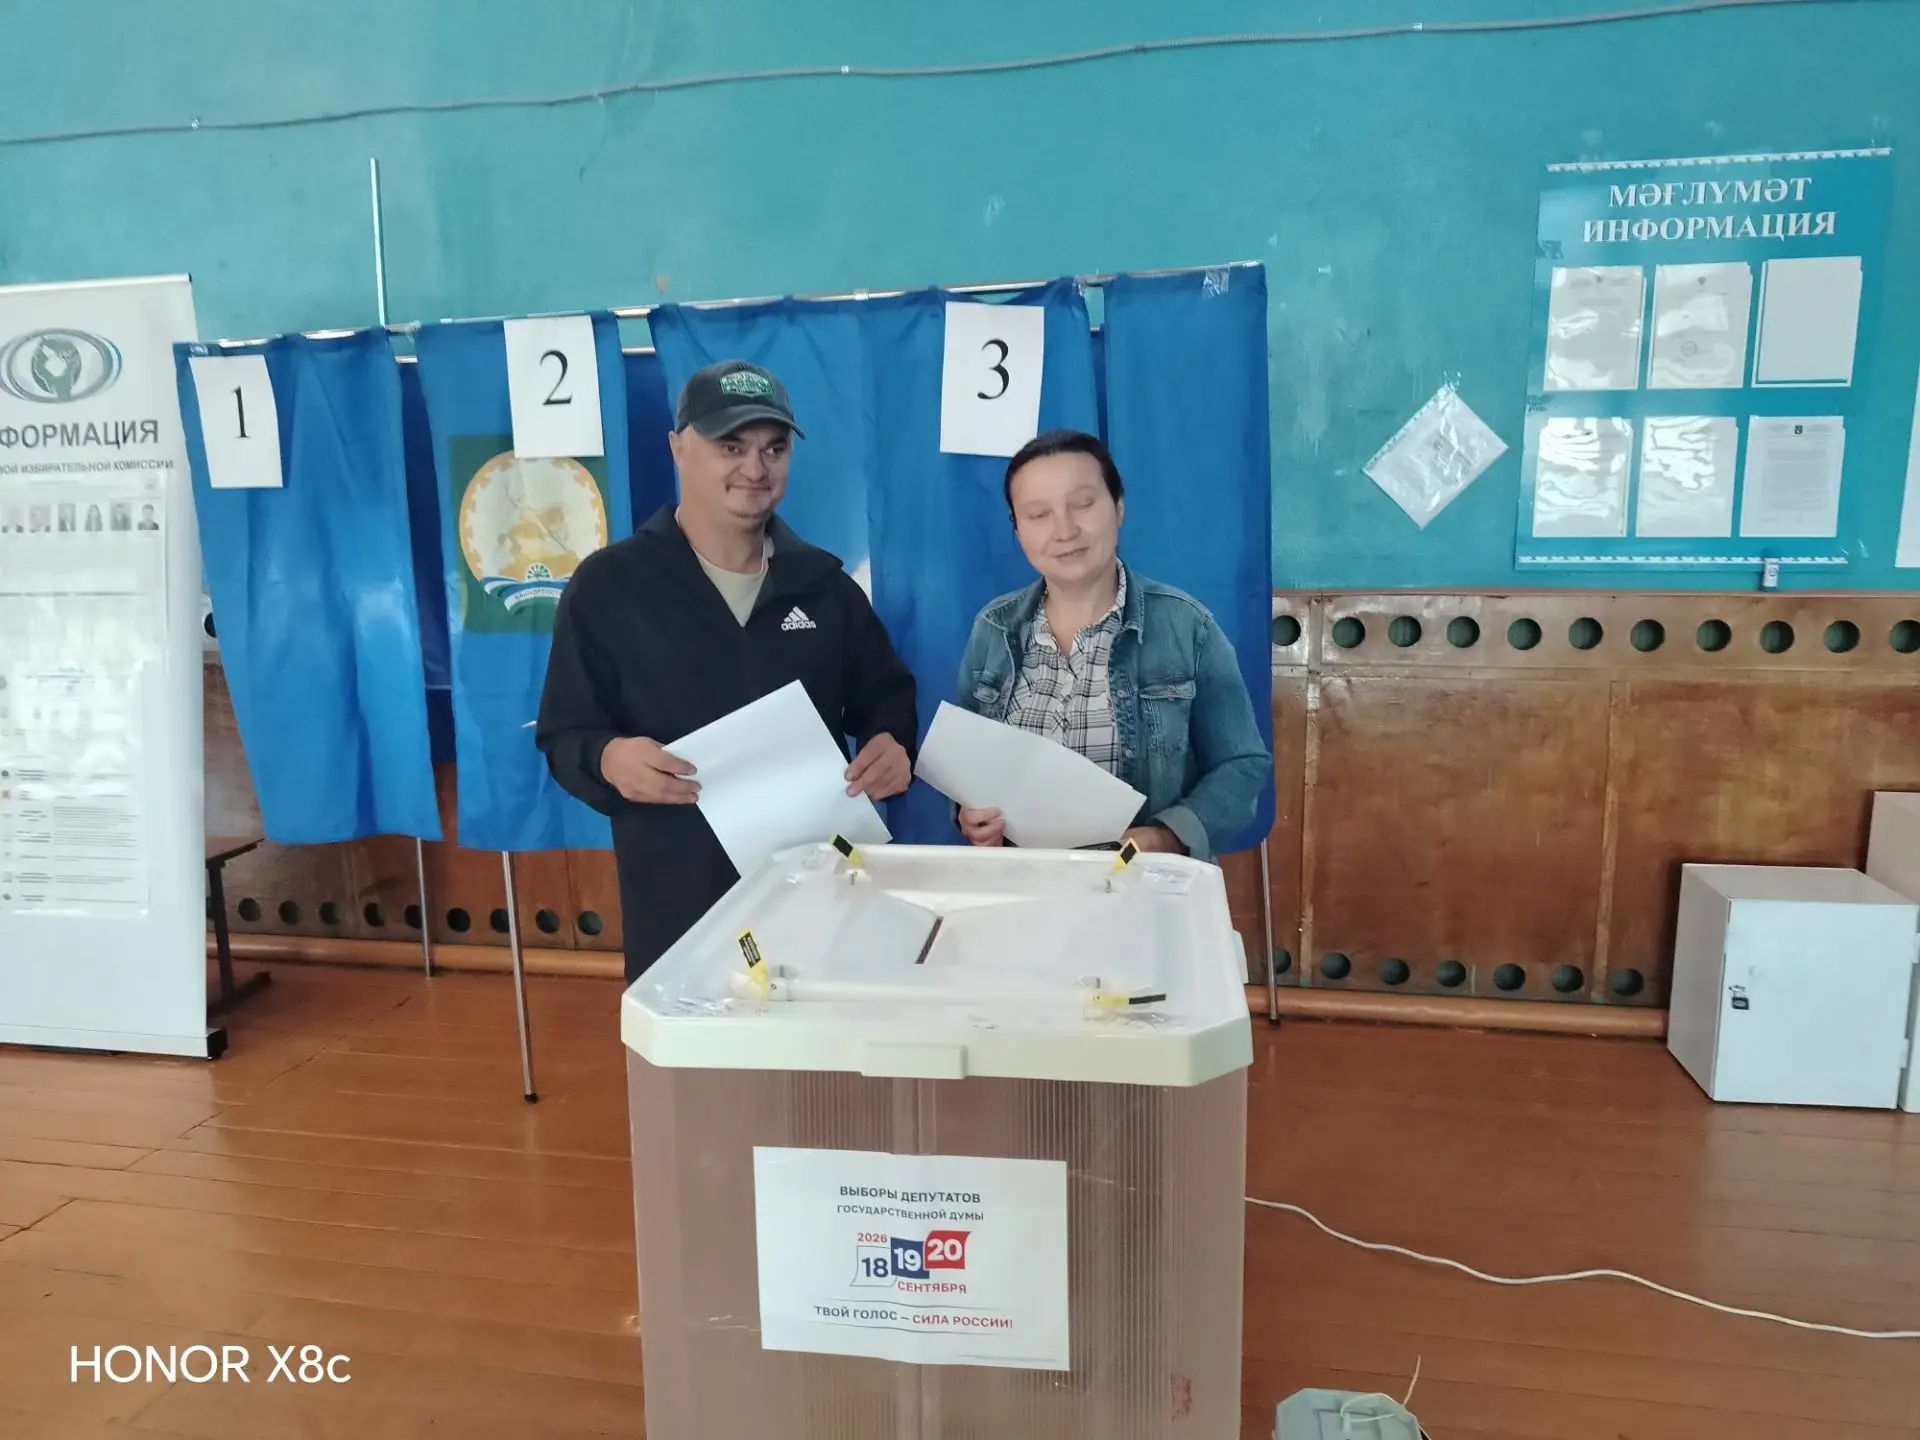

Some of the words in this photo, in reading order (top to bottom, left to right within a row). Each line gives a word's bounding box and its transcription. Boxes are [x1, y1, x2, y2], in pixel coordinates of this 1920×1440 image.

[1608, 177, 1812, 208] МӘҒЛҮМӘТ
[1583, 211, 1837, 242] ИНФОРМАЦИЯ
[539, 349, 573, 406] 2
[977, 338, 1010, 400] 3
[230, 386, 252, 439] 1
[0, 419, 159, 450] ФОРМАЦИЯ
[21, 461, 111, 474] ИЗБИРАТЕЛЬНОЙ
[113, 459, 174, 472] КОМИССИИ
[781, 620, 817, 632] adidas
[840, 1186, 898, 1200] ВЫБОРЫ
[901, 1191, 981, 1203] ДЕПУТАТОВ
[837, 1204, 947, 1220] ГОСУДАРСТВЕННОЙ
[949, 1211, 984, 1221] ДУМЫ
[857, 1232, 888, 1244] 2026
[861, 1257, 889, 1278] 18
[893, 1247, 922, 1272] 19
[926, 1238, 963, 1262] 20
[897, 1280, 967, 1294] СЕНТЯБРЯ
[814, 1305, 850, 1317] ТВОЙ
[853, 1309, 898, 1321] ГОЛОС
[912, 1314, 949, 1325] СИЛА
[953, 1315, 1013, 1329] РОССИИ!
